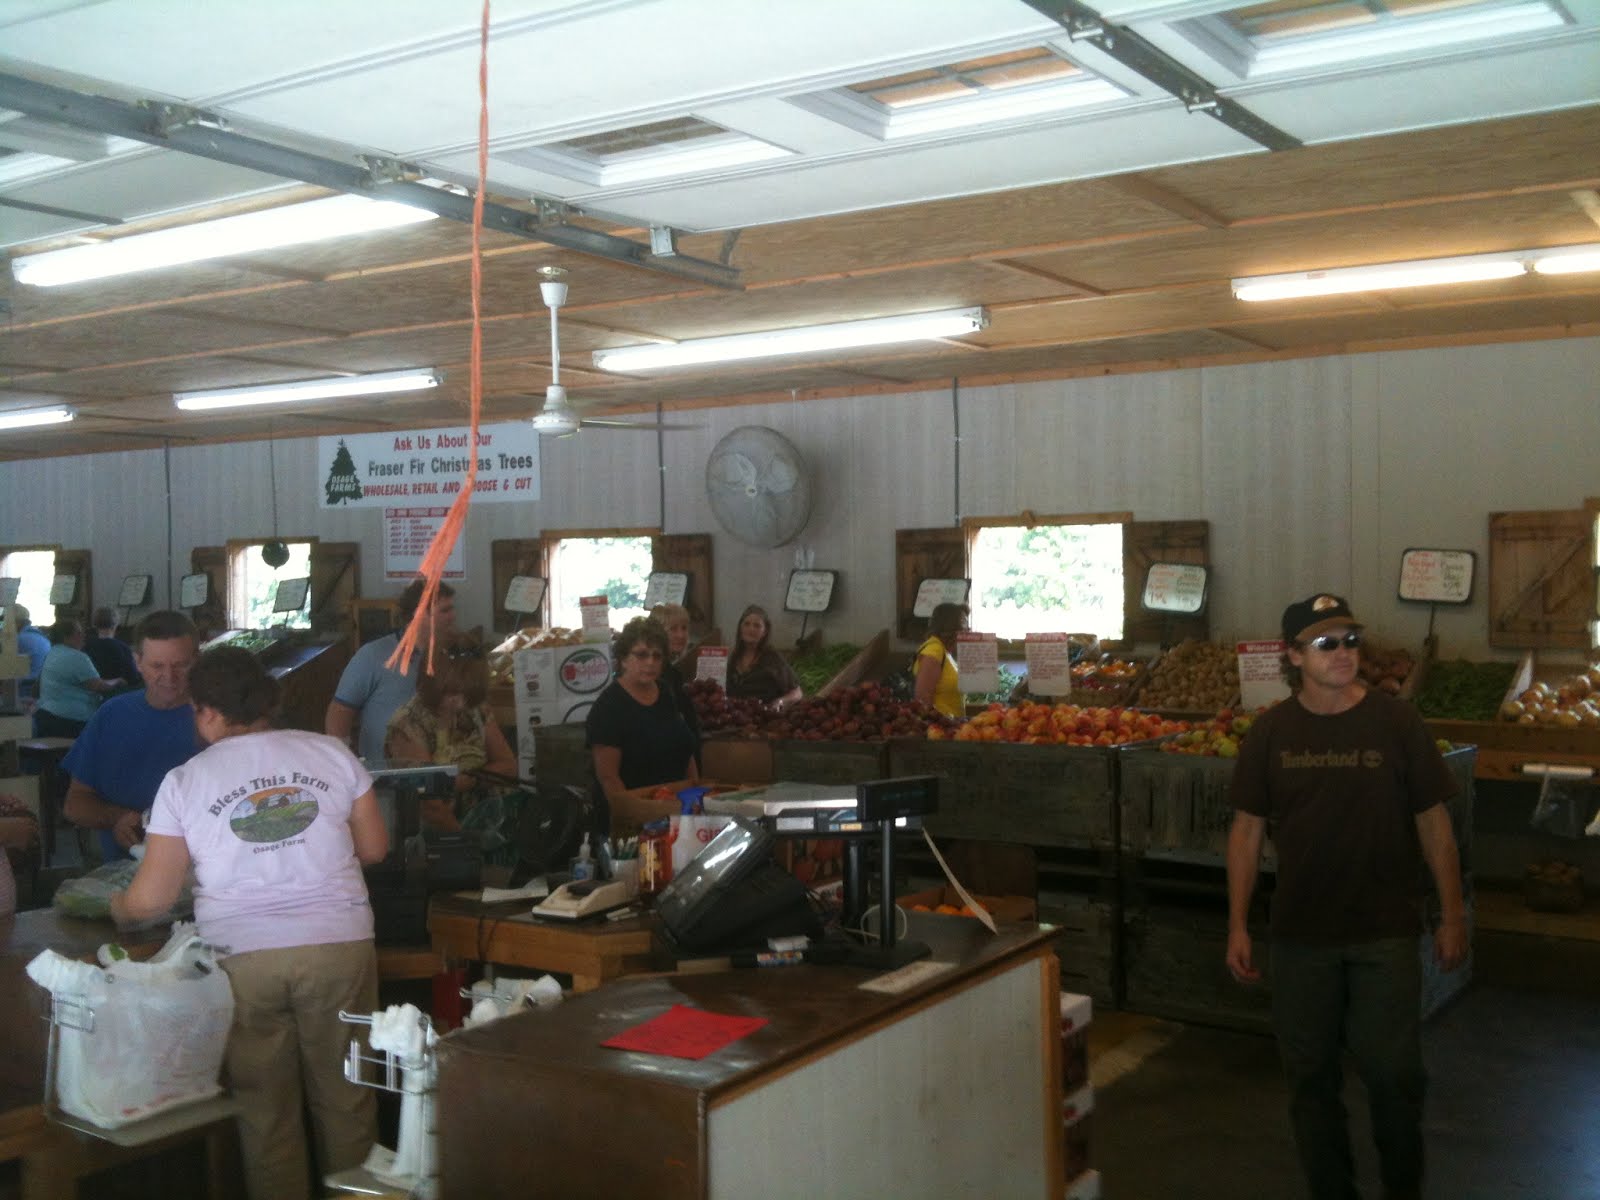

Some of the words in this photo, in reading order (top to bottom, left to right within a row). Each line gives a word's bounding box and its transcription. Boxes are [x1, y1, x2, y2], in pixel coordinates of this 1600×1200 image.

[393, 436, 413, 451] Ask
[417, 435, 431, 449] Us
[437, 433, 468, 449] About
[368, 460, 404, 477] Fraser
[410, 458, 425, 475] Fir
[431, 456, 492, 473] Christas
[498, 452, 533, 470] Trees
[412, 482, 438, 495] RETAIL
[442, 481, 461, 494] AND
[503, 479, 509, 491] &
[515, 477, 532, 490] CUT
[208, 785, 247, 817] Bless
[249, 775, 286, 790] This
[292, 771, 329, 792] Farm
[253, 843, 280, 854] Osage
[281, 838, 306, 848] Farm
